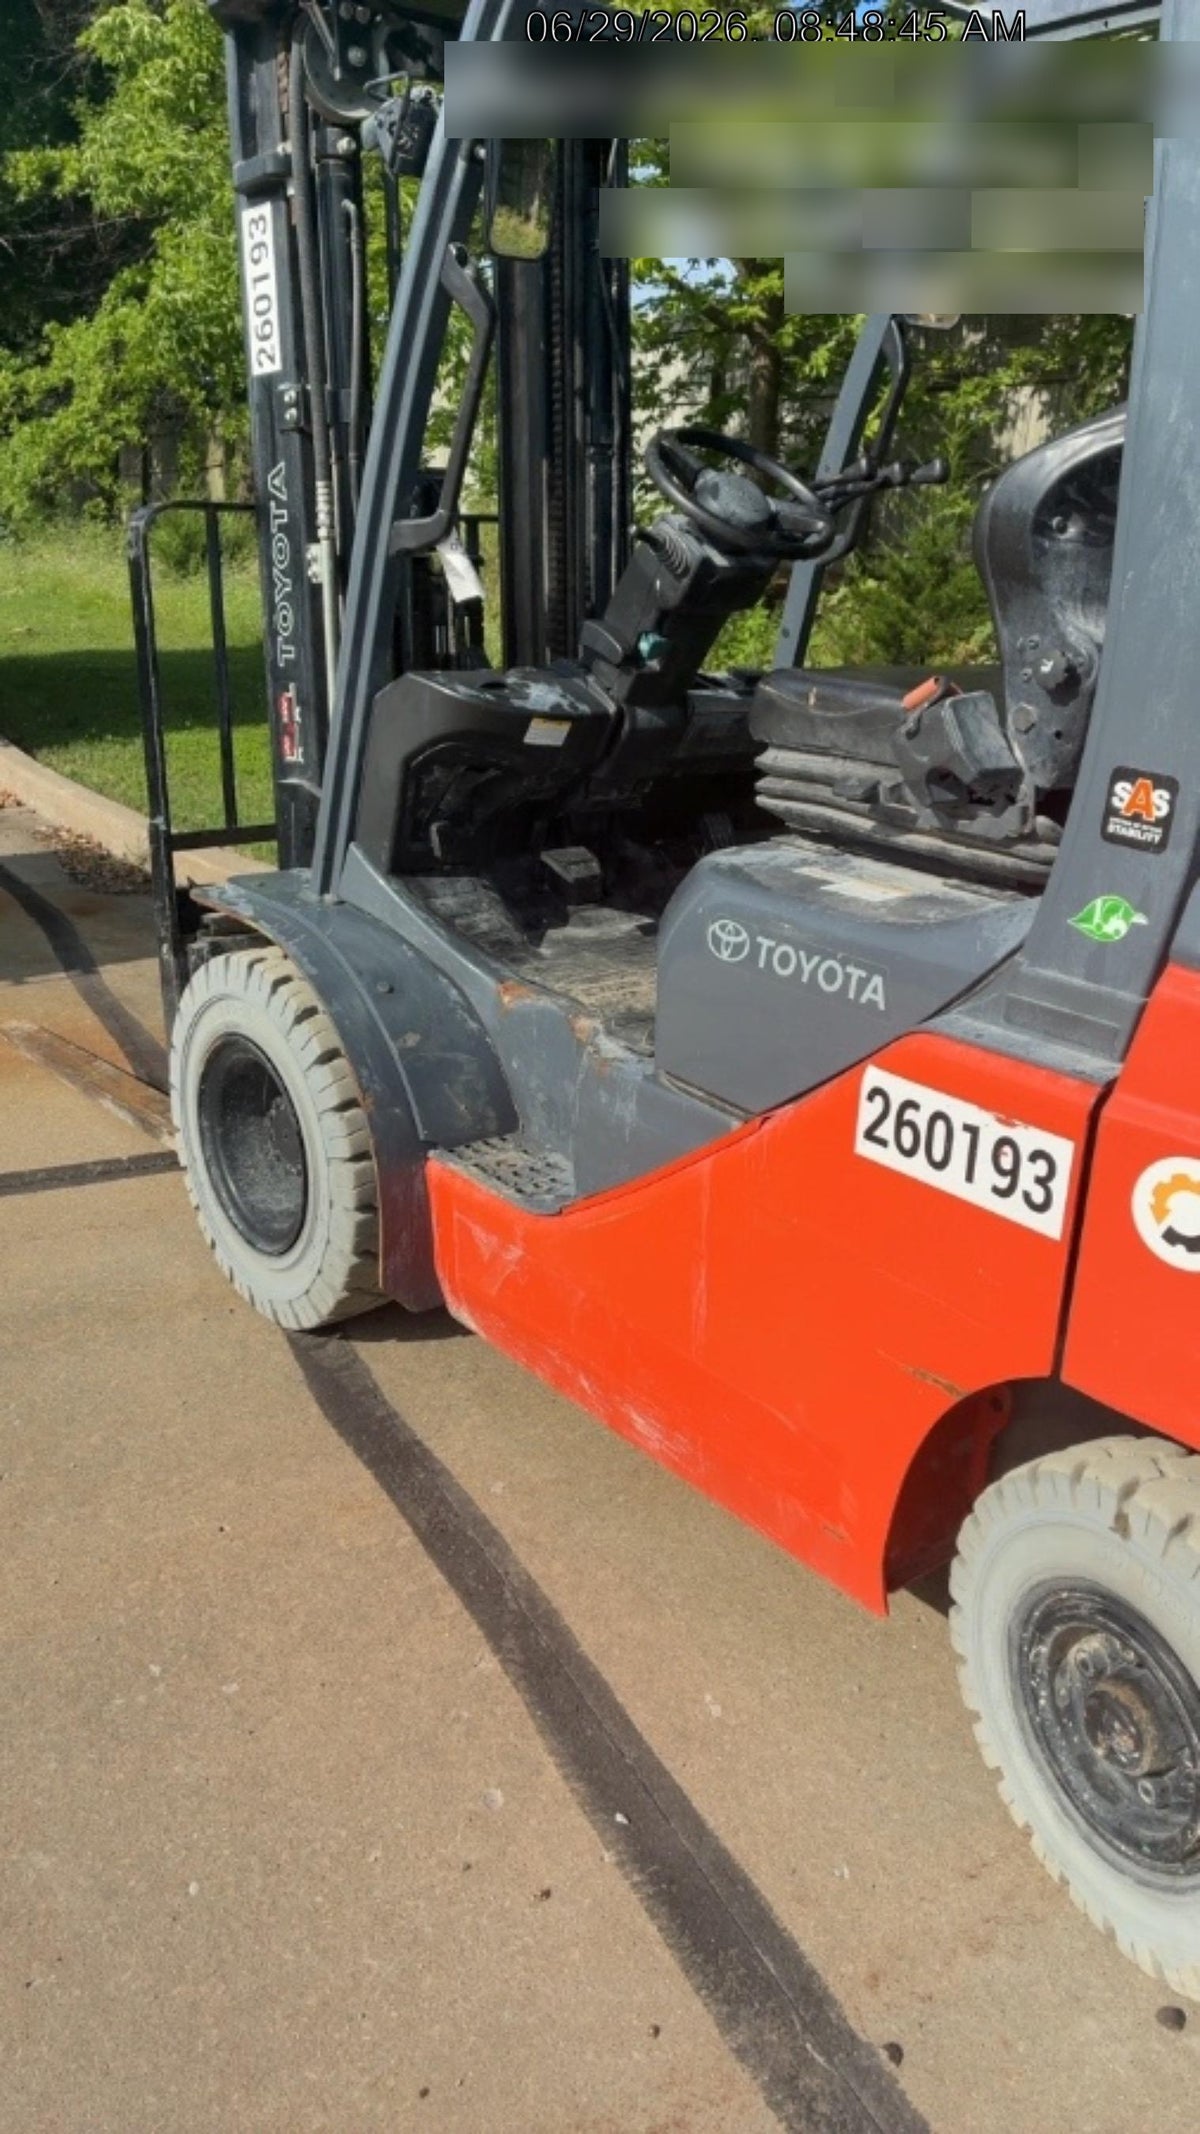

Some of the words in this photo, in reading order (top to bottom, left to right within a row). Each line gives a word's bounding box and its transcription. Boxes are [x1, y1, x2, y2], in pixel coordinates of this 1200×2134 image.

[248, 213, 277, 368] 260193
[267, 462, 295, 667] TOYOTA
[1111, 776, 1170, 822] SAS
[756, 936, 886, 1011] TOYOTA
[863, 1086, 1057, 1214] 260193
